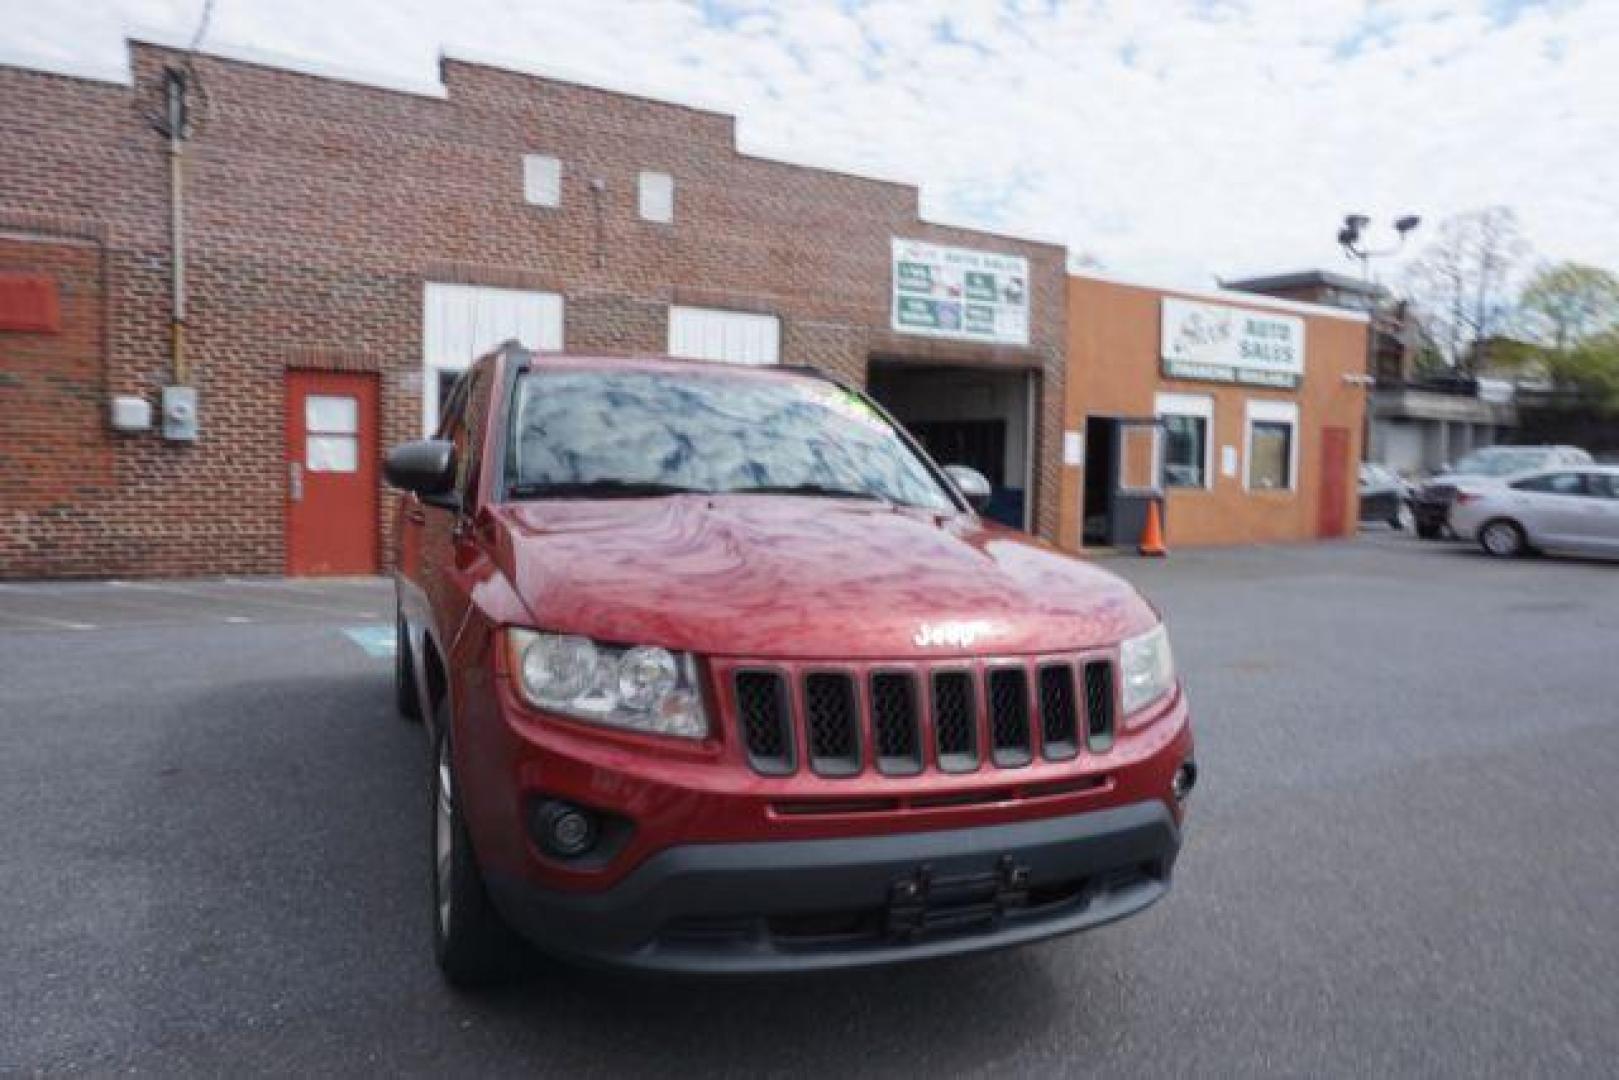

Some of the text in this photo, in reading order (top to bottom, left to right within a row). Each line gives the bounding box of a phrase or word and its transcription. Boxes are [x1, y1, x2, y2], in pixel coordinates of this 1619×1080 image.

[1245, 319, 1291, 340] AUTO
[1241, 339, 1295, 361] SALES
[913, 622, 976, 648] Jeep
